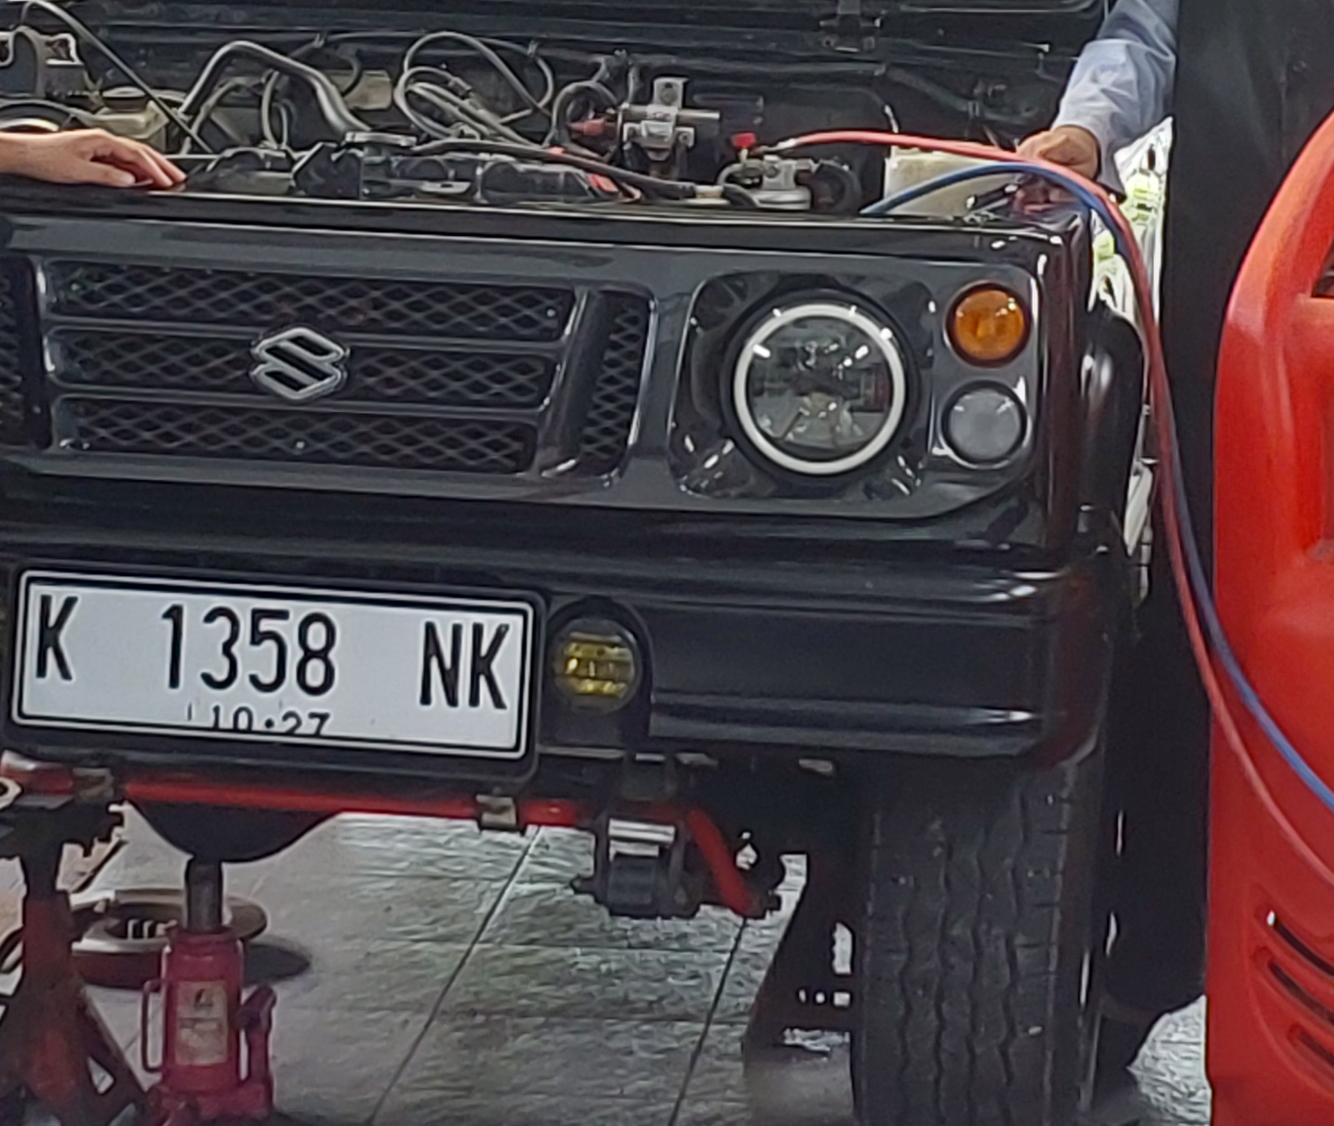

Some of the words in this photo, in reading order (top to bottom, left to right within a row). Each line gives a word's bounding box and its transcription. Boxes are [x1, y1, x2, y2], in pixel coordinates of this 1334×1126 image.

[34, 593, 79, 683] K
[160, 602, 338, 697] 1358
[419, 619, 511, 710] NK
